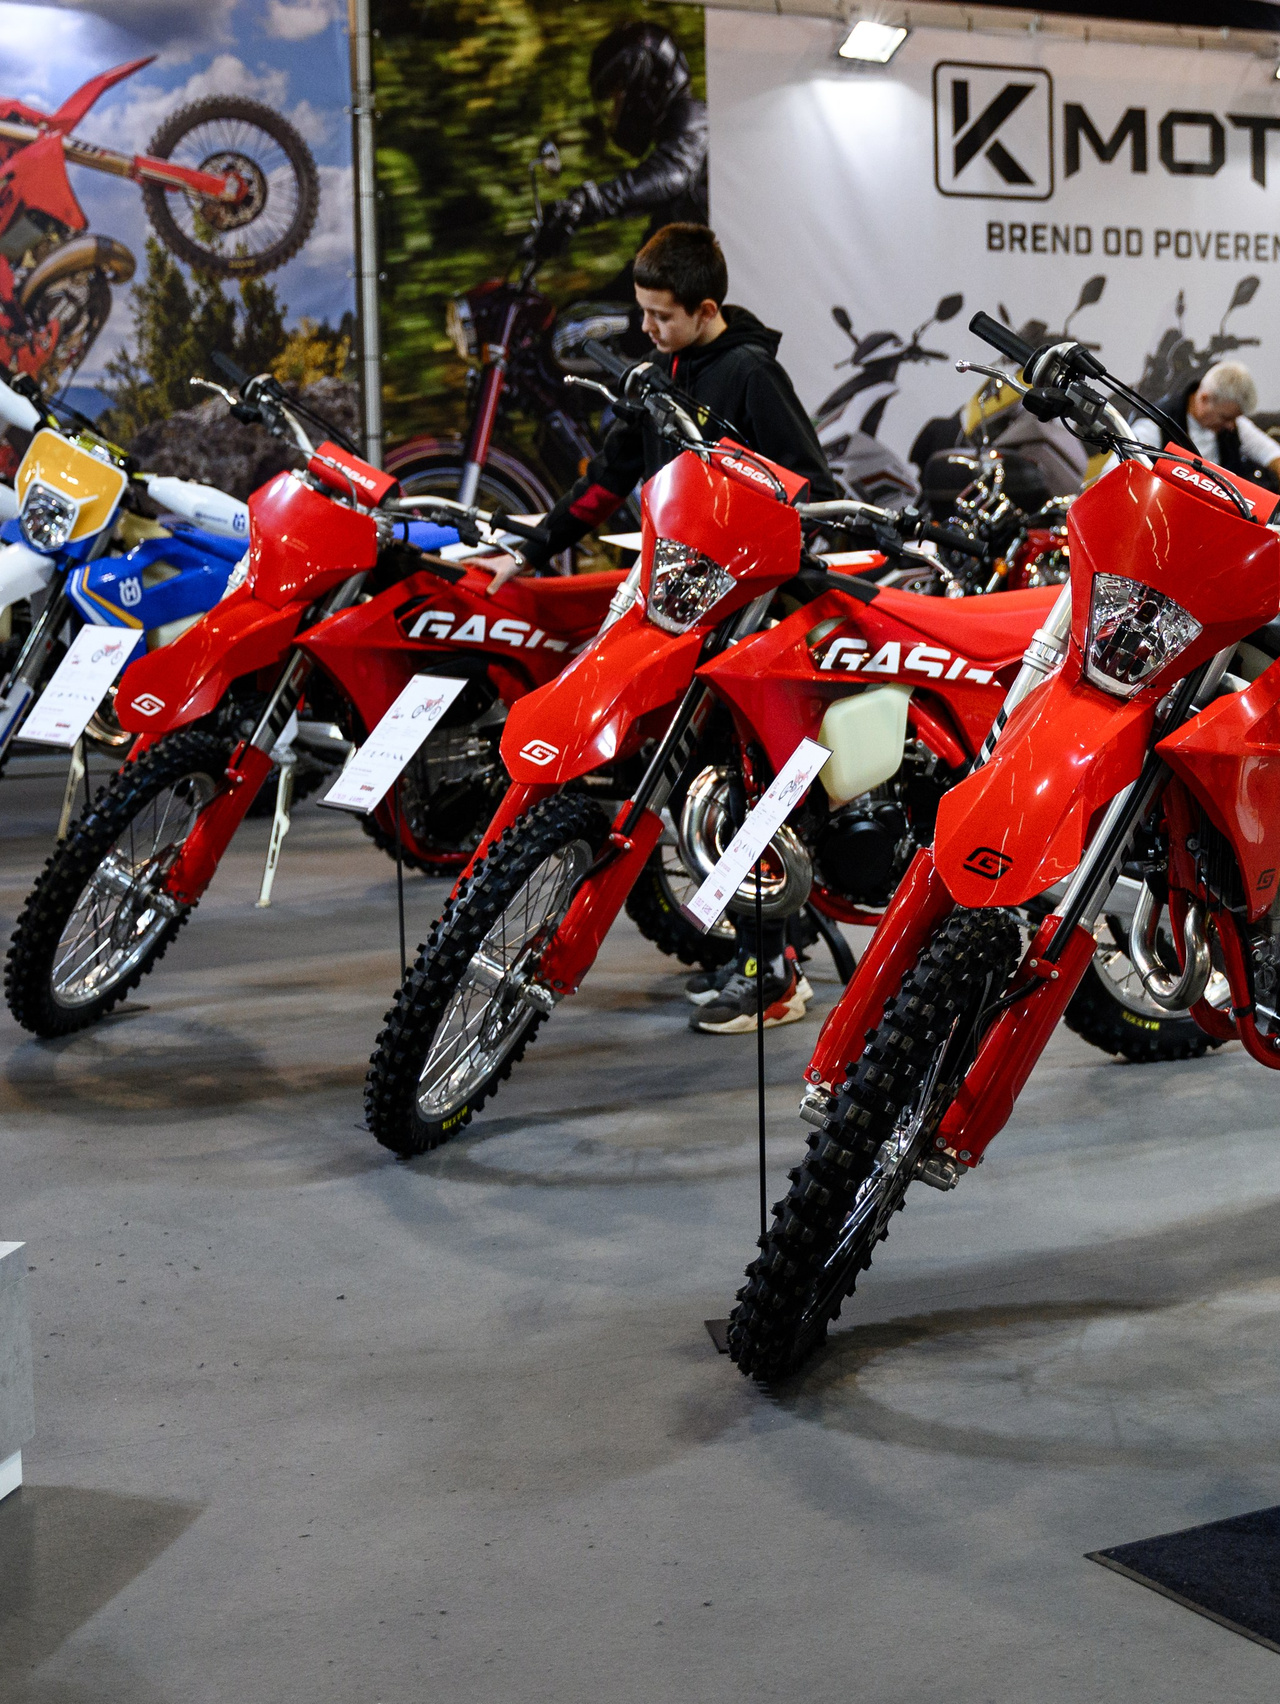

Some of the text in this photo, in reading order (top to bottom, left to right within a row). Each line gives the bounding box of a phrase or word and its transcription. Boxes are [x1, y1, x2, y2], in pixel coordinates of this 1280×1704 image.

[952, 79, 1036, 186] K
[987, 221, 1092, 256] BREND
[1103, 226, 1142, 257] OD
